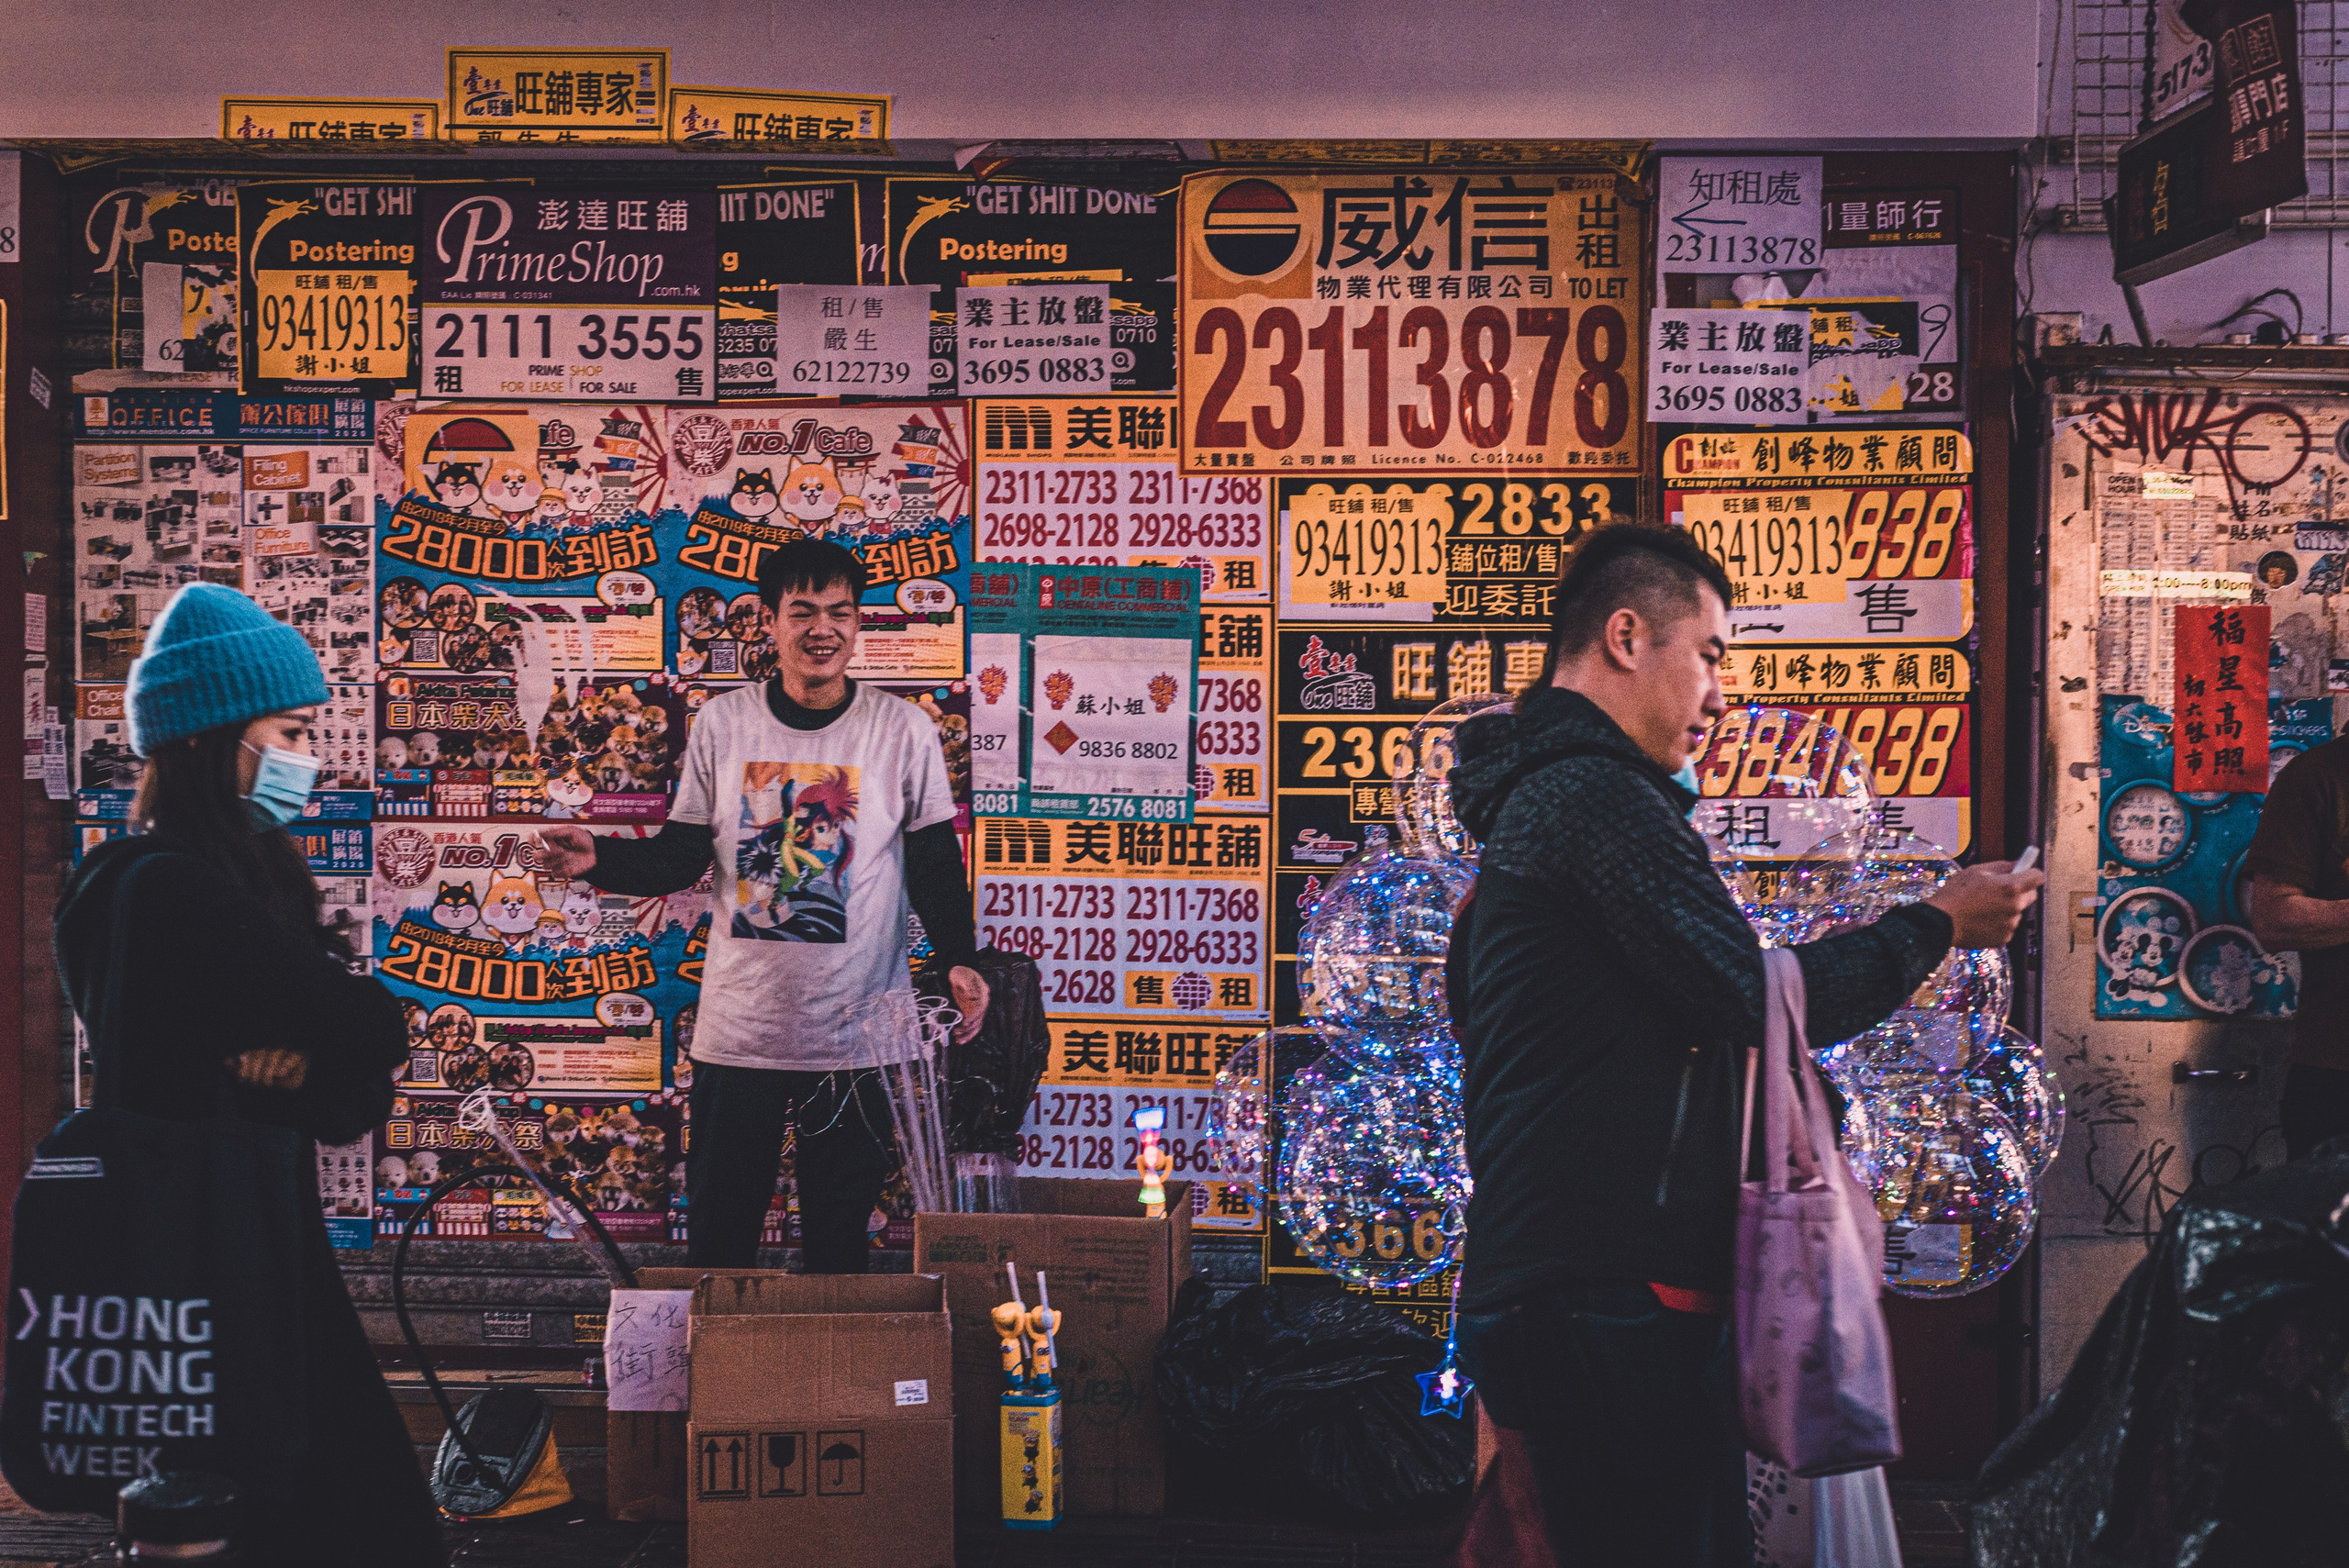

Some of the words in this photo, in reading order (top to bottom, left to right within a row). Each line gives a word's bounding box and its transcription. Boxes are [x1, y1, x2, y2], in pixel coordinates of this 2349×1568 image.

[516, 71, 635, 116] 旺舖專家
[1029, 184, 1083, 215] SHIT
[1687, 169, 1802, 206] 知租處
[537, 198, 688, 232] 澎達旺舖
[1316, 175, 1555, 272] 威信
[436, 195, 664, 298] PrimeShop
[1576, 195, 1621, 270] 出租
[290, 239, 415, 265] Postering
[940, 237, 1068, 264] Postering
[1665, 233, 1817, 266] 23113878
[295, 275, 330, 290] 旺舖
[336, 274, 378, 291] 租/售
[1316, 274, 1553, 300] 物業代理有限公司
[1568, 277, 1594, 300] TO
[1596, 277, 1629, 300] LET
[262, 294, 406, 352] 93419313
[964, 295, 1105, 328] 業主放盤
[434, 313, 552, 359] 2111
[576, 314, 704, 361] 3555
[968, 336, 997, 350] For
[1003, 334, 1101, 350] Lease/Sale
[1116, 328, 1157, 343] 0710
[1657, 320, 1804, 353] 業主放盤
[295, 355, 373, 376] 謝小姐
[433, 364, 463, 394] 租
[528, 364, 565, 377] PRIME
[569, 365, 604, 377] SHOP
[793, 359, 911, 384] 62122739
[964, 358, 1030, 384] 3695
[1038, 357, 1105, 384] 0883
[1194, 305, 1630, 450] 23113878
[1661, 361, 1692, 375] For
[1698, 362, 1800, 377] Lease/Sale
[501, 381, 525, 393] FOR
[529, 381, 564, 393] LEASE
[579, 382, 604, 394] FOR
[608, 382, 638, 394] SALE
[674, 366, 704, 396] 售
[1654, 385, 1726, 412] 3695
[1734, 385, 1803, 413] 0883
[111, 407, 213, 426] OFFICE
[815, 426, 874, 454] Cafe
[1753, 434, 1958, 473] 創峰物業顧問
[1372, 453, 1426, 465] Licence
[1435, 453, 1463, 465] No.
[1470, 450, 1544, 465] C-022468
[252, 472, 302, 488] Cabinet
[985, 469, 1119, 506] 2311-2733
[1128, 469, 1264, 506] 2311-7368
[1667, 478, 1742, 490] Champion
[1746, 476, 1812, 489] Property
[1817, 474, 1905, 487] Consultants
[1909, 473, 1969, 485] Limited
[1329, 498, 1365, 515] 旺舖
[1723, 496, 1760, 514] 旺舖
[254, 527, 292, 540] Office
[984, 512, 1119, 549] 2698-2128
[1128, 512, 1263, 549] 2928-6333
[1295, 517, 1443, 578] 93419313
[1223, 560, 1257, 590] 租
[1329, 580, 1409, 601] 謝小姐
[1854, 582, 1919, 634] 售
[1750, 652, 1955, 691] 創峰物業顧問
[1074, 695, 1146, 717] 蘇小姐
[1744, 693, 1809, 706] Property
[1813, 692, 1903, 705] Consultants
[1906, 691, 1965, 704] Limited
[2208, 610, 2246, 776] 福星高照
[1078, 740, 1127, 759] 9836
[1130, 741, 1178, 761] 8802
[1223, 768, 1256, 797] 租
[973, 794, 1019, 814] 8081
[1087, 796, 1136, 819] 2576
[1140, 798, 1187, 820] 8081
[1066, 821, 1262, 869] 美聯旺舖
[983, 882, 1116, 919] 2311-2733
[1126, 885, 1260, 923] 2311-7368
[1125, 929, 1258, 965] 2928-6333
[1132, 974, 1163, 1005] 售
[1219, 976, 1253, 1006] 租
[49, 1294, 214, 1344] HONG
[614, 1302, 685, 1331] 文化
[43, 1346, 216, 1396] KONG
[41, 1401, 216, 1438] FINTECH
[40, 1441, 163, 1478] WEEK
